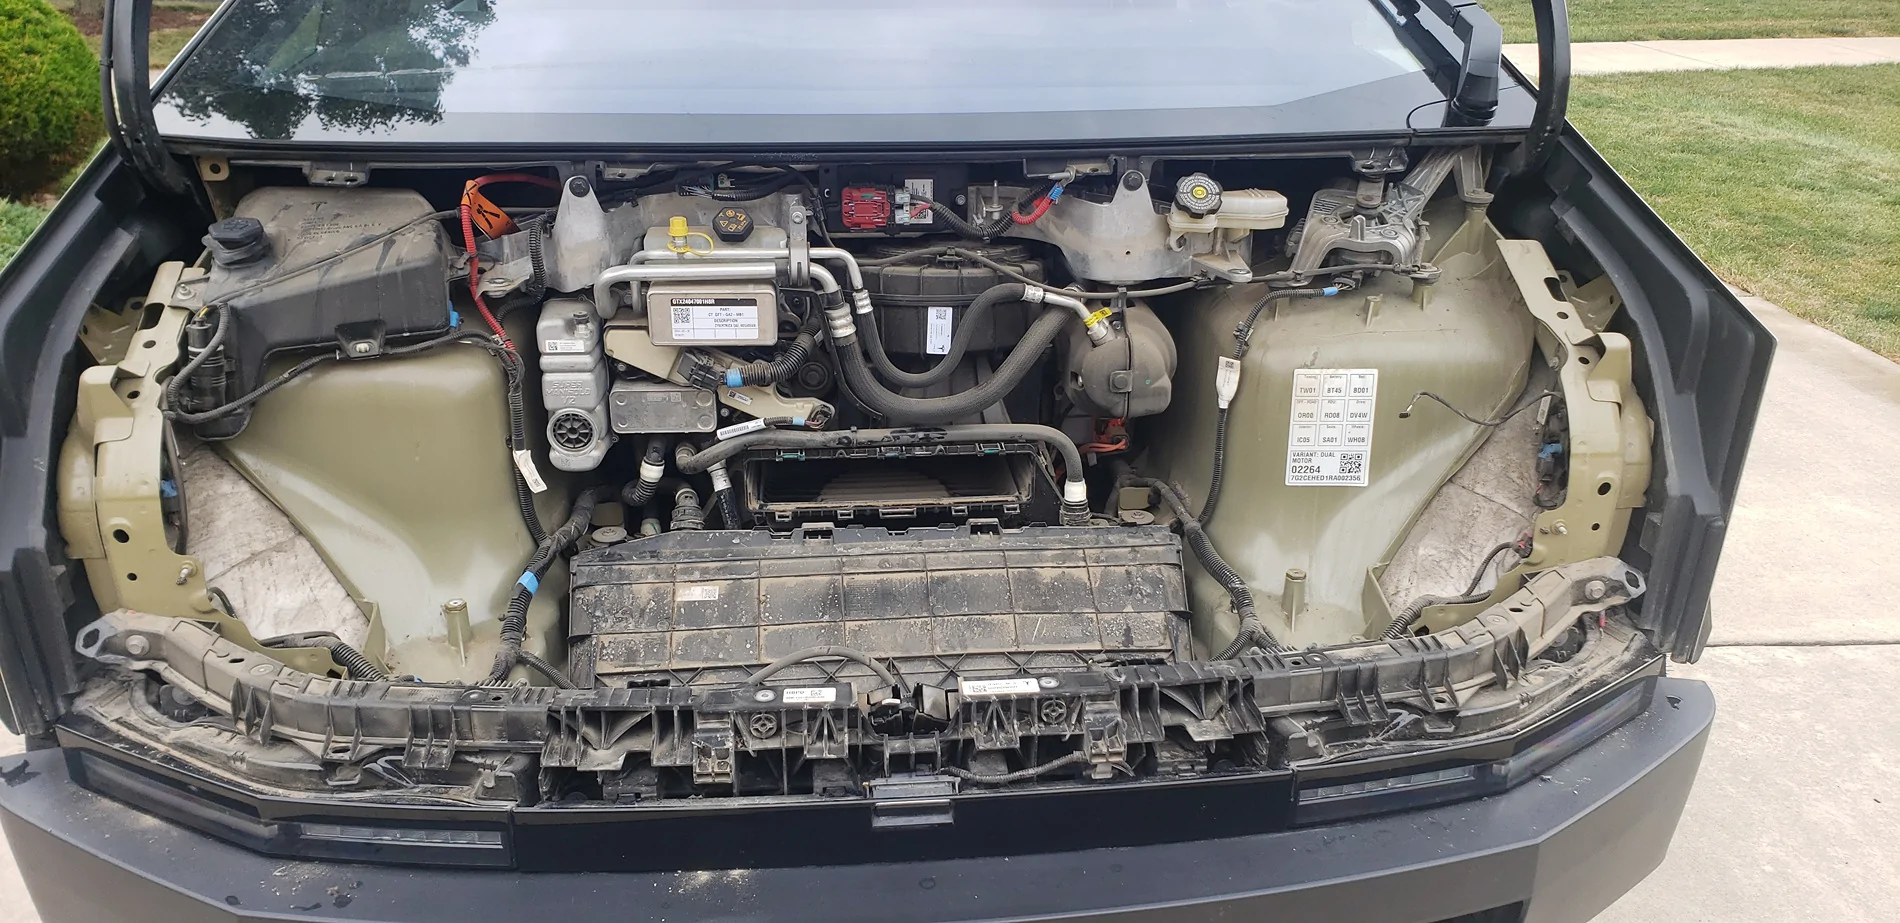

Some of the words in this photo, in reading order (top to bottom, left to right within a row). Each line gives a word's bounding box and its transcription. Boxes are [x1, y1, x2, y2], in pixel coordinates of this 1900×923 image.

[552, 380, 583, 389] SUPER
[545, 388, 591, 396] MANIFOLD
[1291, 465, 1321, 474] 02264
